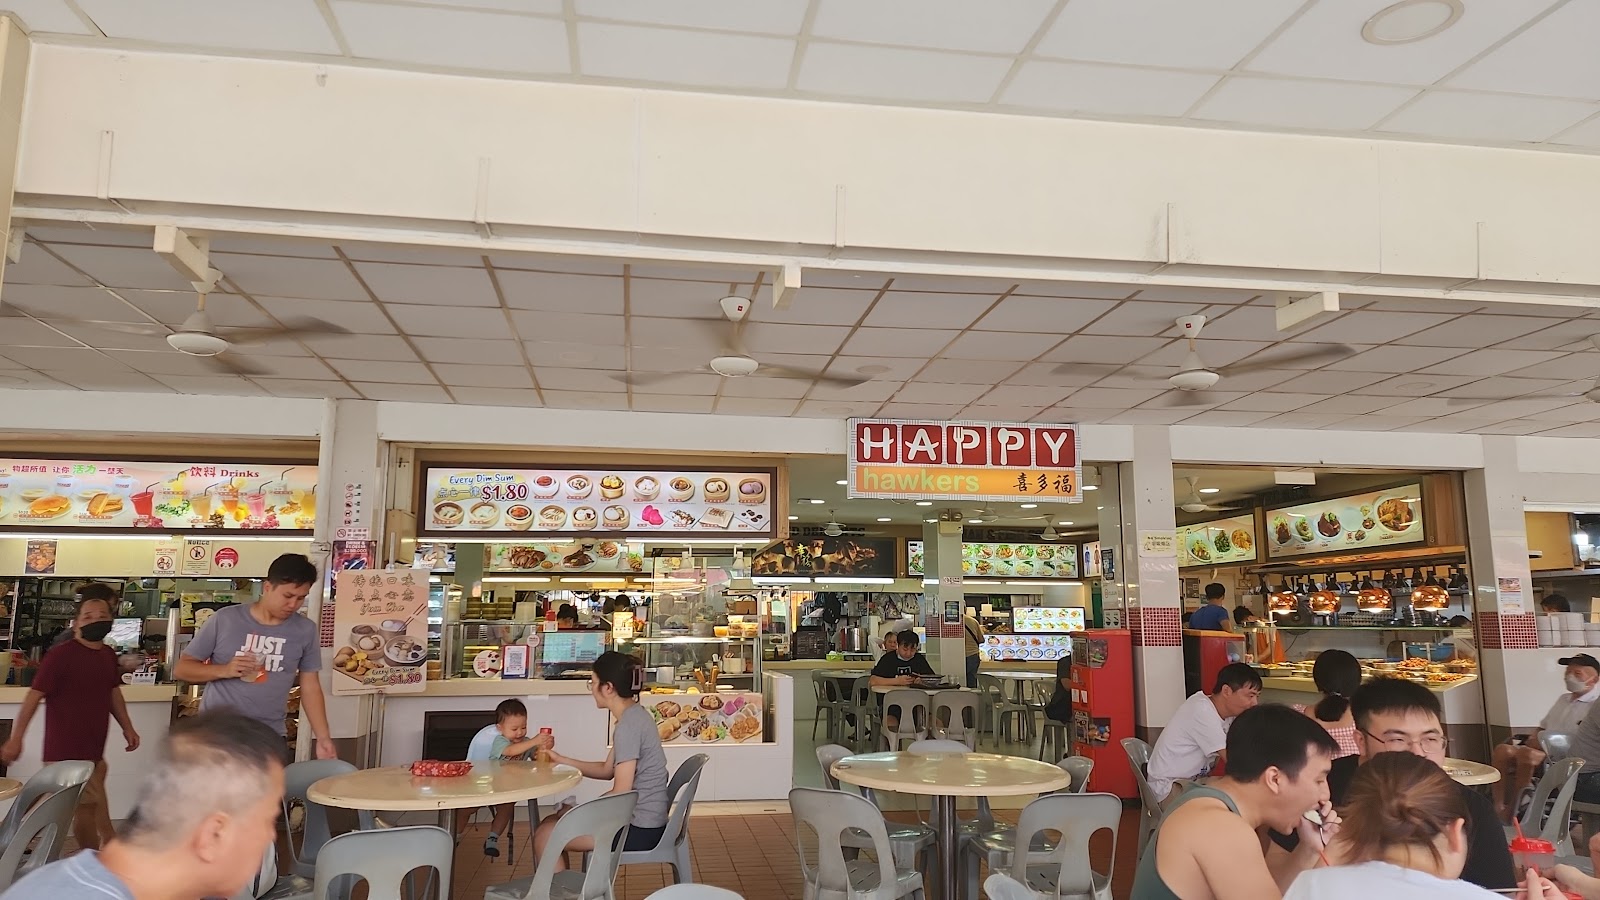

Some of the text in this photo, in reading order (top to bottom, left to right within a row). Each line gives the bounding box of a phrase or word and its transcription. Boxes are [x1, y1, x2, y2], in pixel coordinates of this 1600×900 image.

[860, 426, 1068, 465] HAPPY
[12, 465, 47, 473] 物超所值
[189, 466, 260, 478] 饮料 Drinks
[449, 473, 514, 485] Every Dim Sum
[863, 467, 980, 493] hawkers
[1013, 472, 1072, 494] 喜多福
[481, 484, 529, 501] $1.80
[352, 573, 415, 588] 传统口味
[360, 601, 405, 616] Yum Cha
[241, 633, 287, 654] JUST
[265, 655, 285, 672] IT.
[389, 672, 423, 686] $1.80
